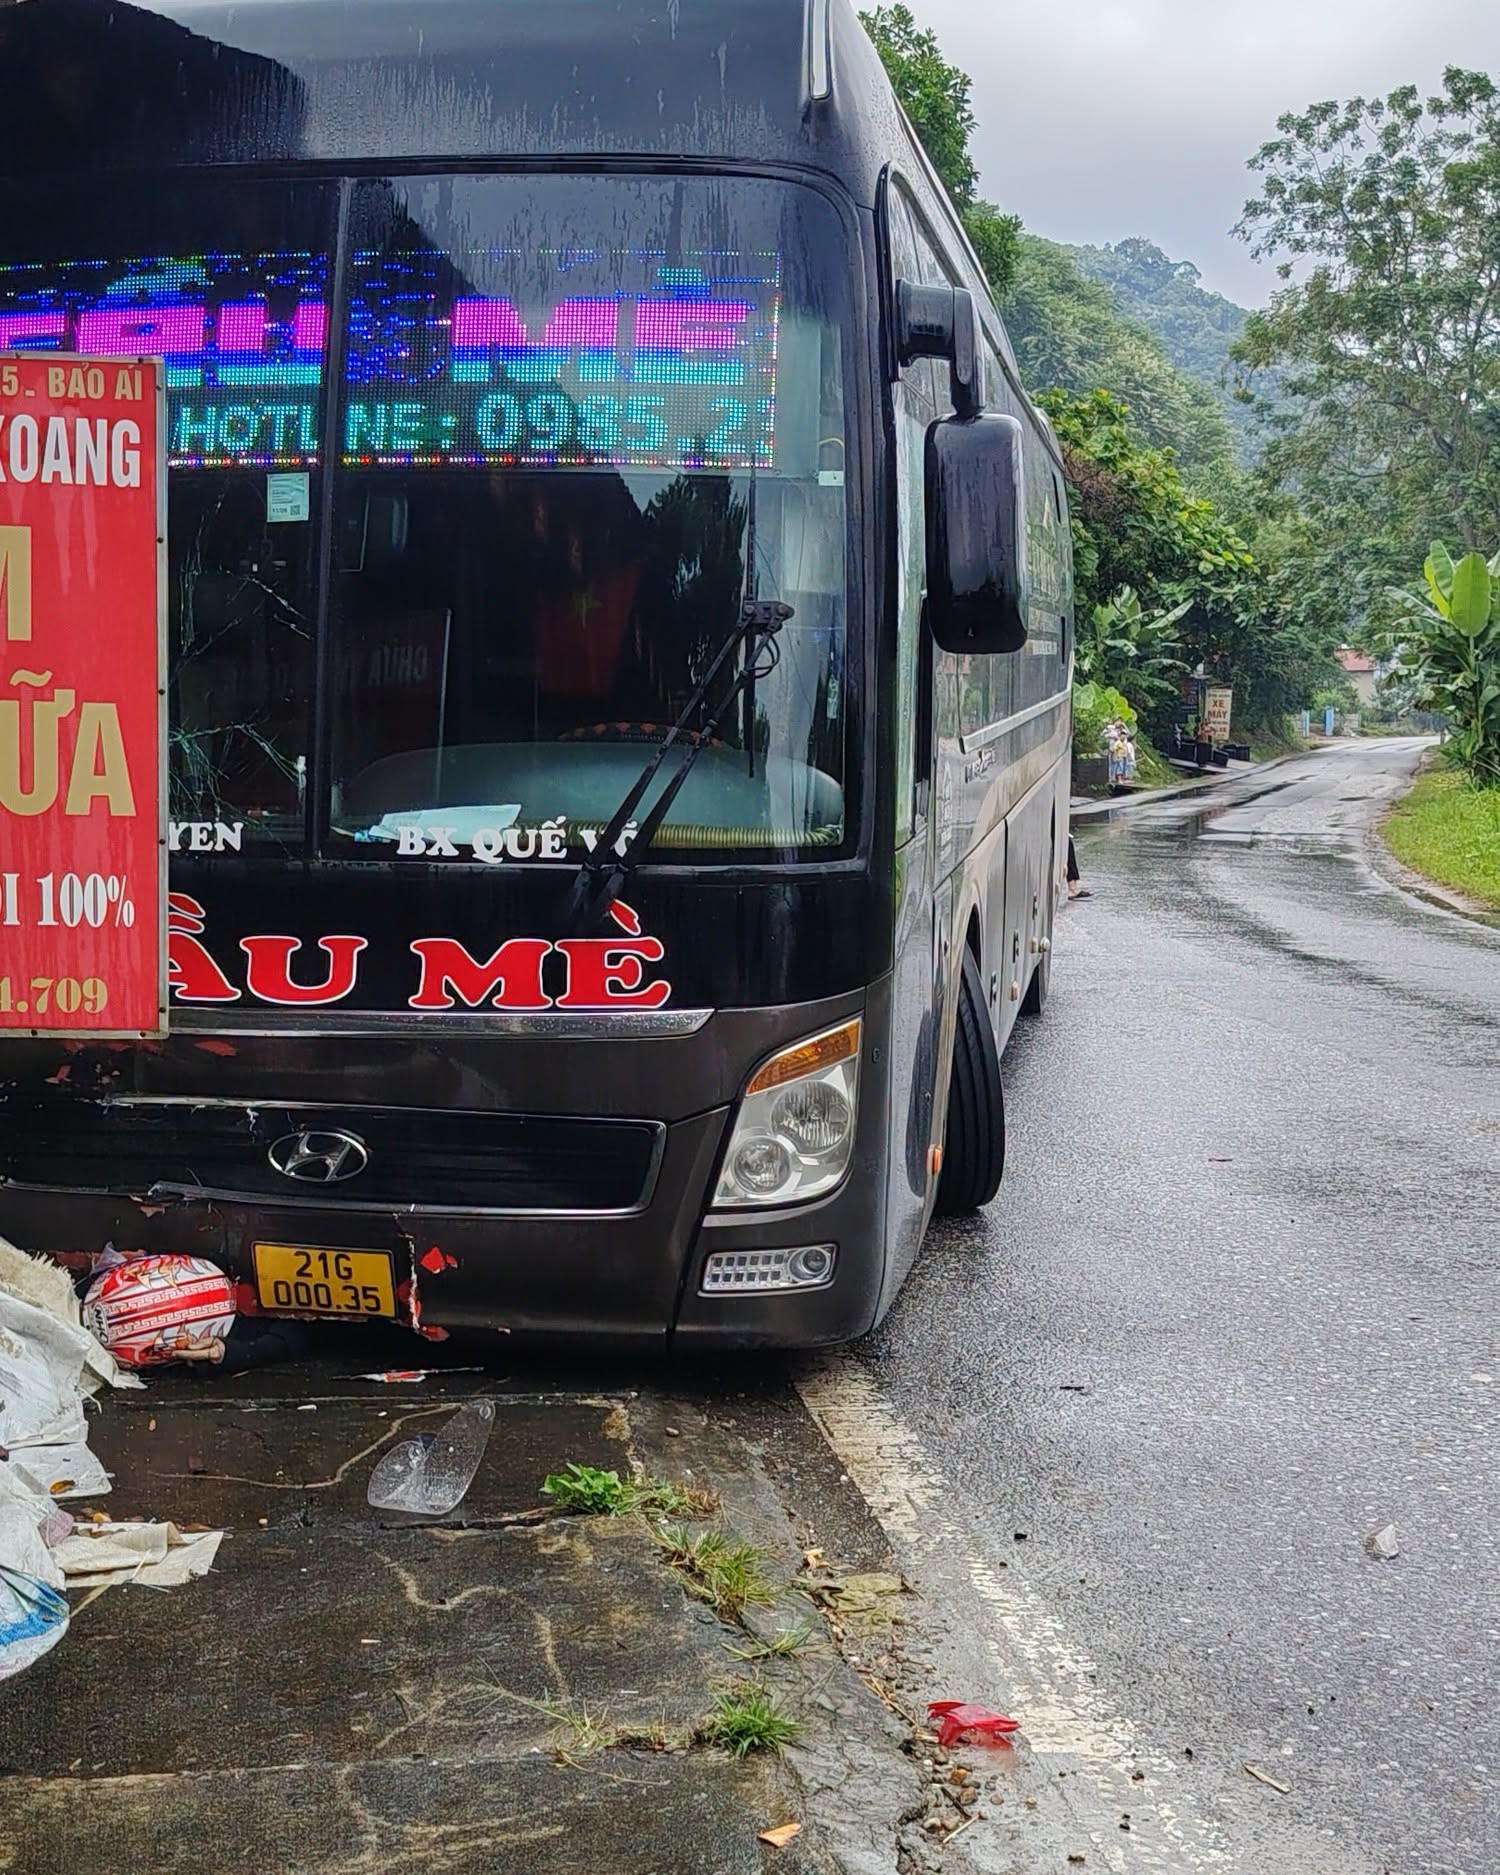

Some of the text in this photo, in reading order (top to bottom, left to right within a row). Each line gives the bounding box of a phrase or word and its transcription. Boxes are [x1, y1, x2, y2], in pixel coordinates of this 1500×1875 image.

[48, 362, 105, 399] BẢO
[0, 414, 141, 488] OANG
[1212, 700, 1225, 709] XE
[396, 825, 459, 857] BX
[471, 815, 567, 864] QUẾ
[36, 872, 135, 928] 100%
[408, 899, 671, 1010] MÈ
[294, 1251, 353, 1281] 21G
[273, 1280, 381, 1312] 000.35
